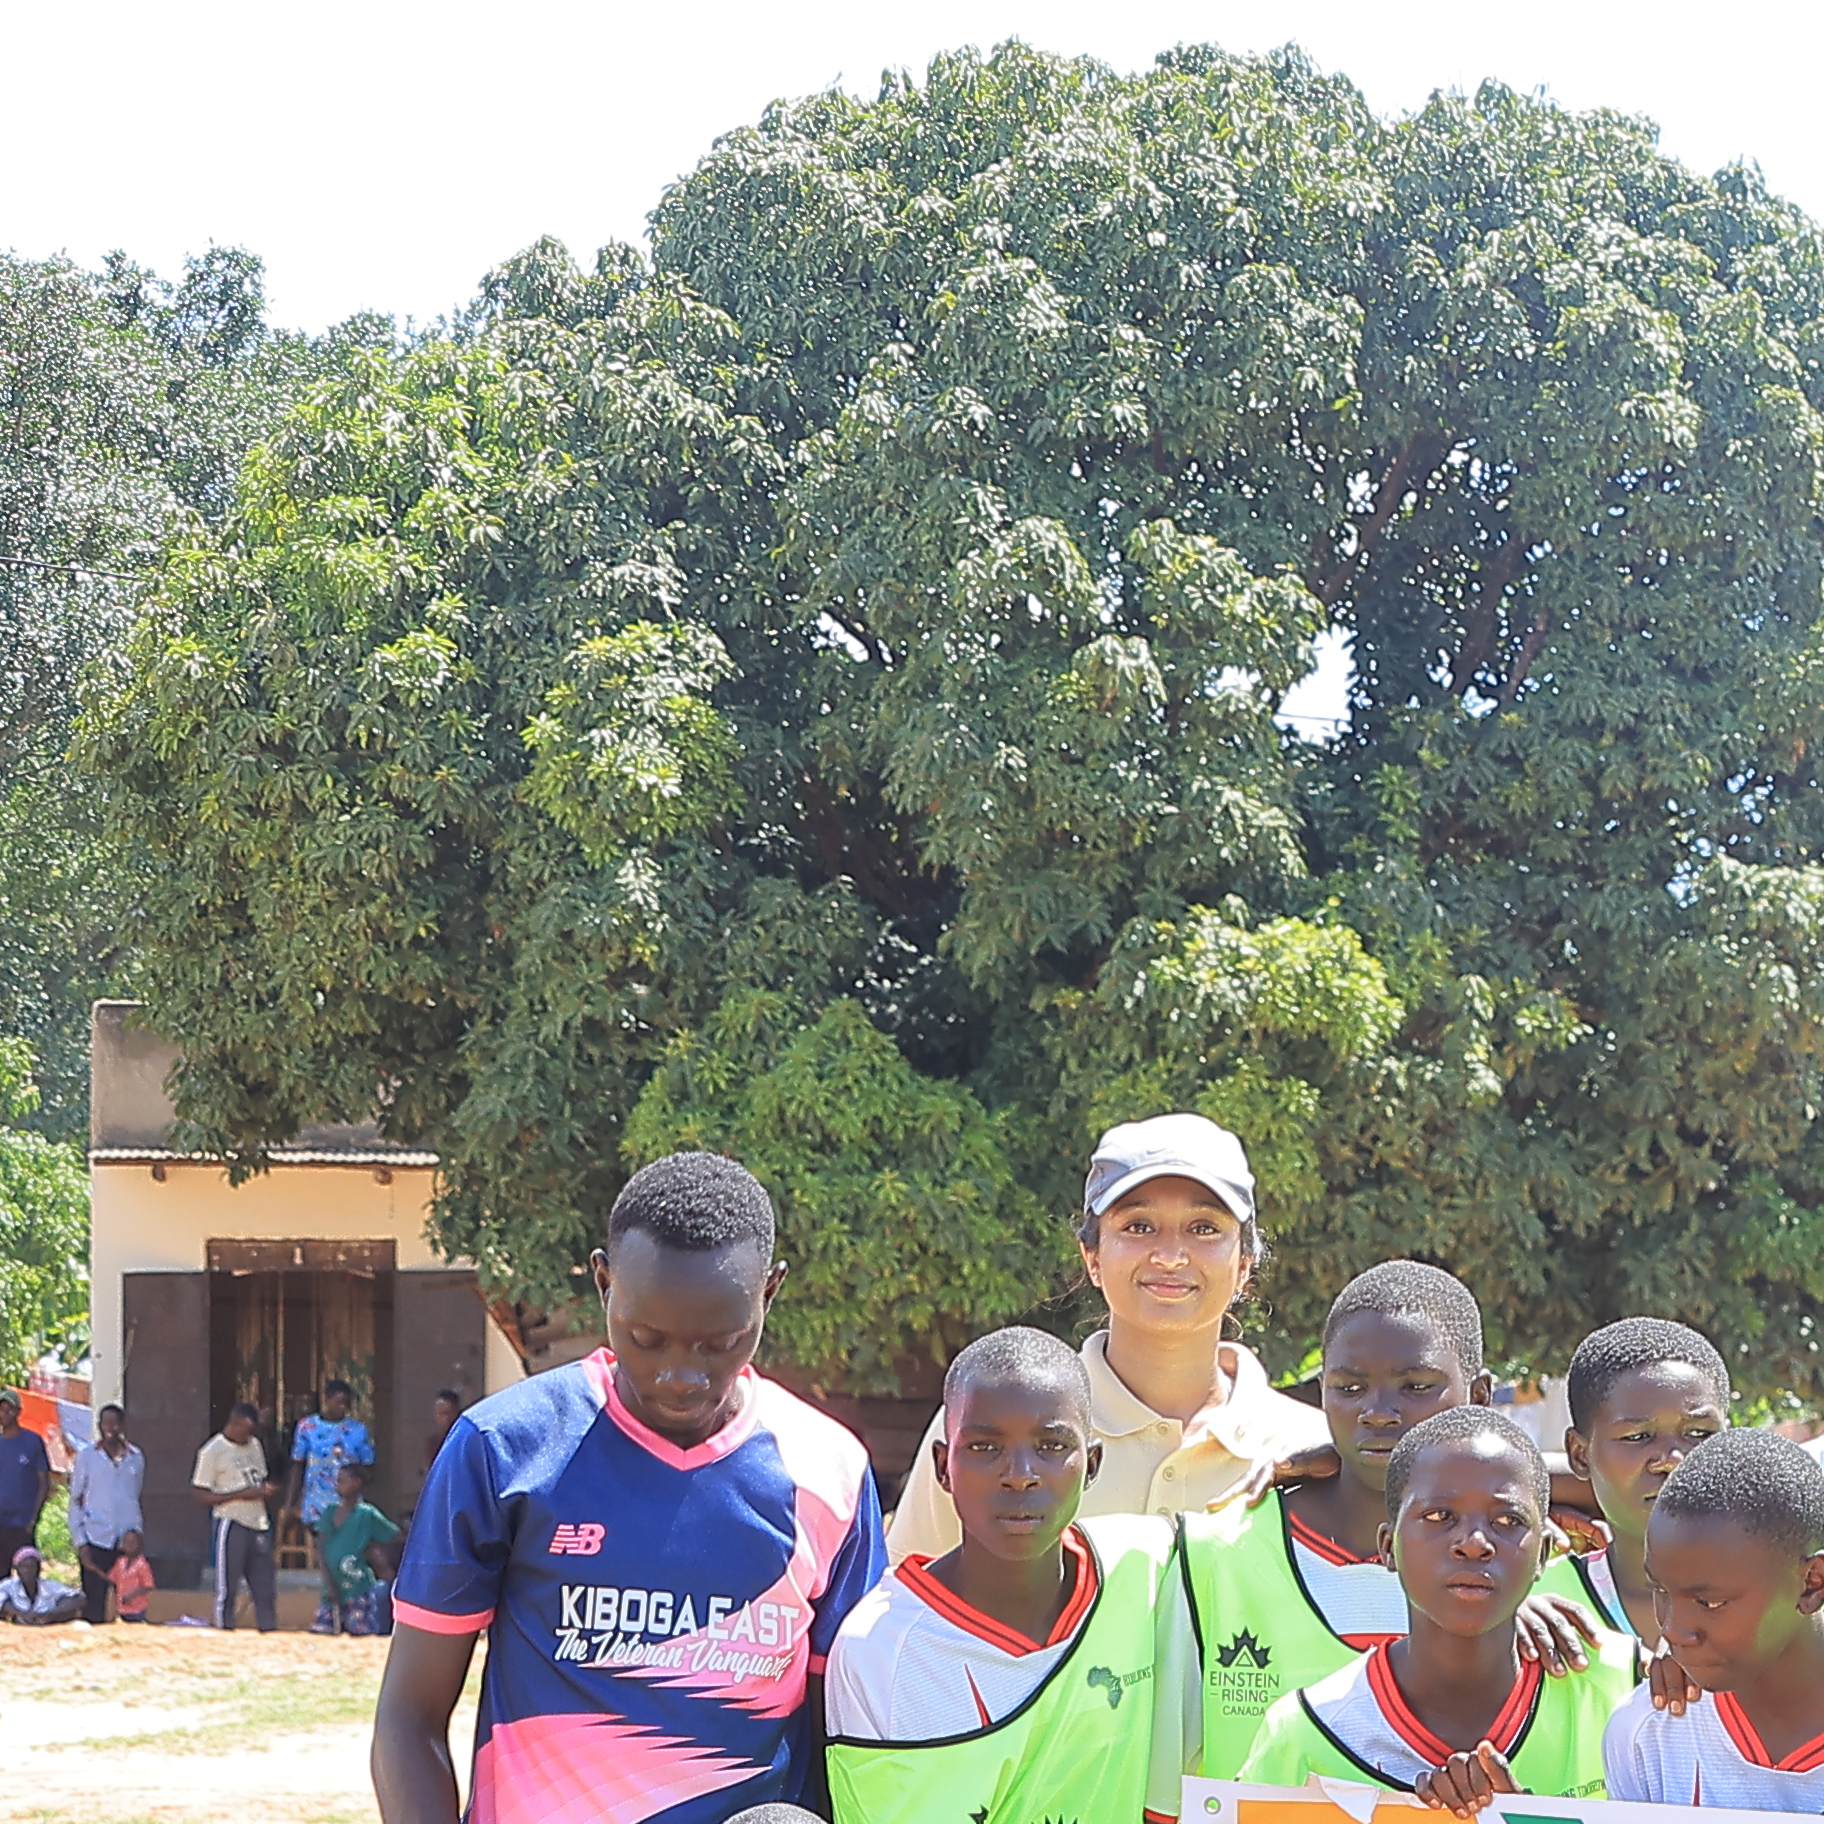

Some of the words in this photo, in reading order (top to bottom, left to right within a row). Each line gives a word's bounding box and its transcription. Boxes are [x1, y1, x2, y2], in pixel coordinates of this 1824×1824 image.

[561, 1584, 698, 1637] KIBOGA
[707, 1596, 800, 1650] EAST
[554, 1628, 588, 1661] The
[591, 1630, 683, 1669] Veteran
[1210, 1671, 1280, 1688] EINSTEIN
[1222, 1688, 1268, 1703] RISING
[1222, 1705, 1266, 1716] CANADA
